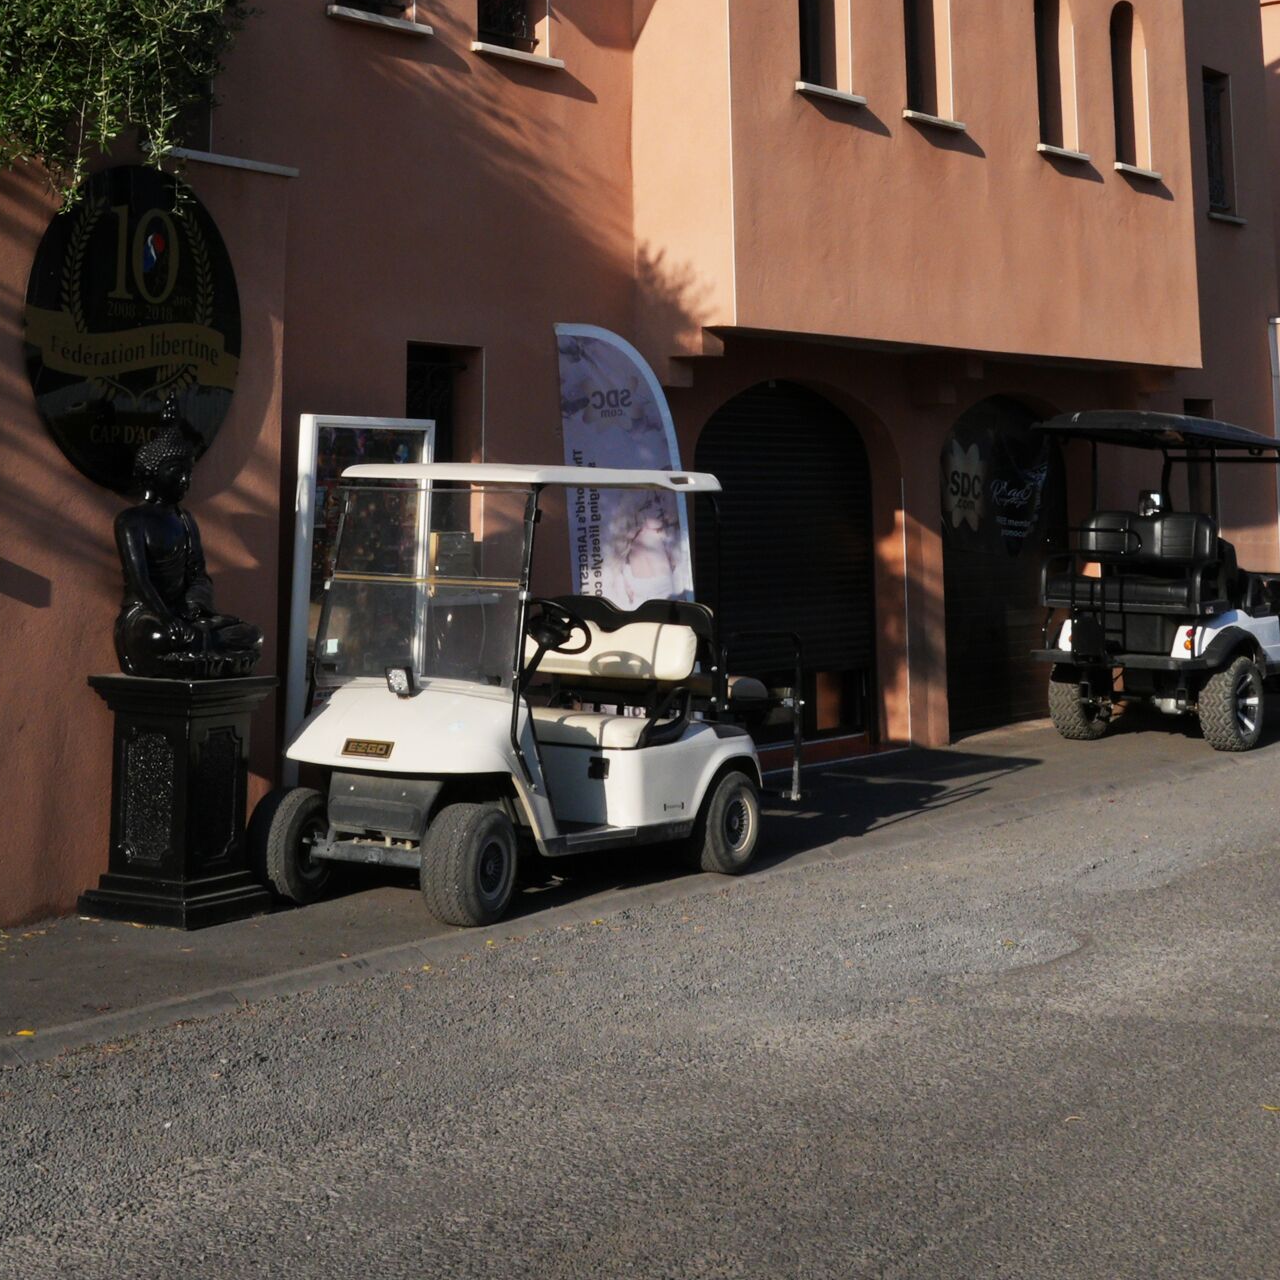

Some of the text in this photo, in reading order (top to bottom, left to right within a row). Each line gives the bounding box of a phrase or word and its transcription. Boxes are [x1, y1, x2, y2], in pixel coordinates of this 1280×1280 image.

[107, 204, 180, 304] 10
[51, 331, 219, 367] Fédération libertine
[90, 425, 120, 445] CAP
[950, 471, 982, 499] SDC
[955, 498, 976, 511] .com
